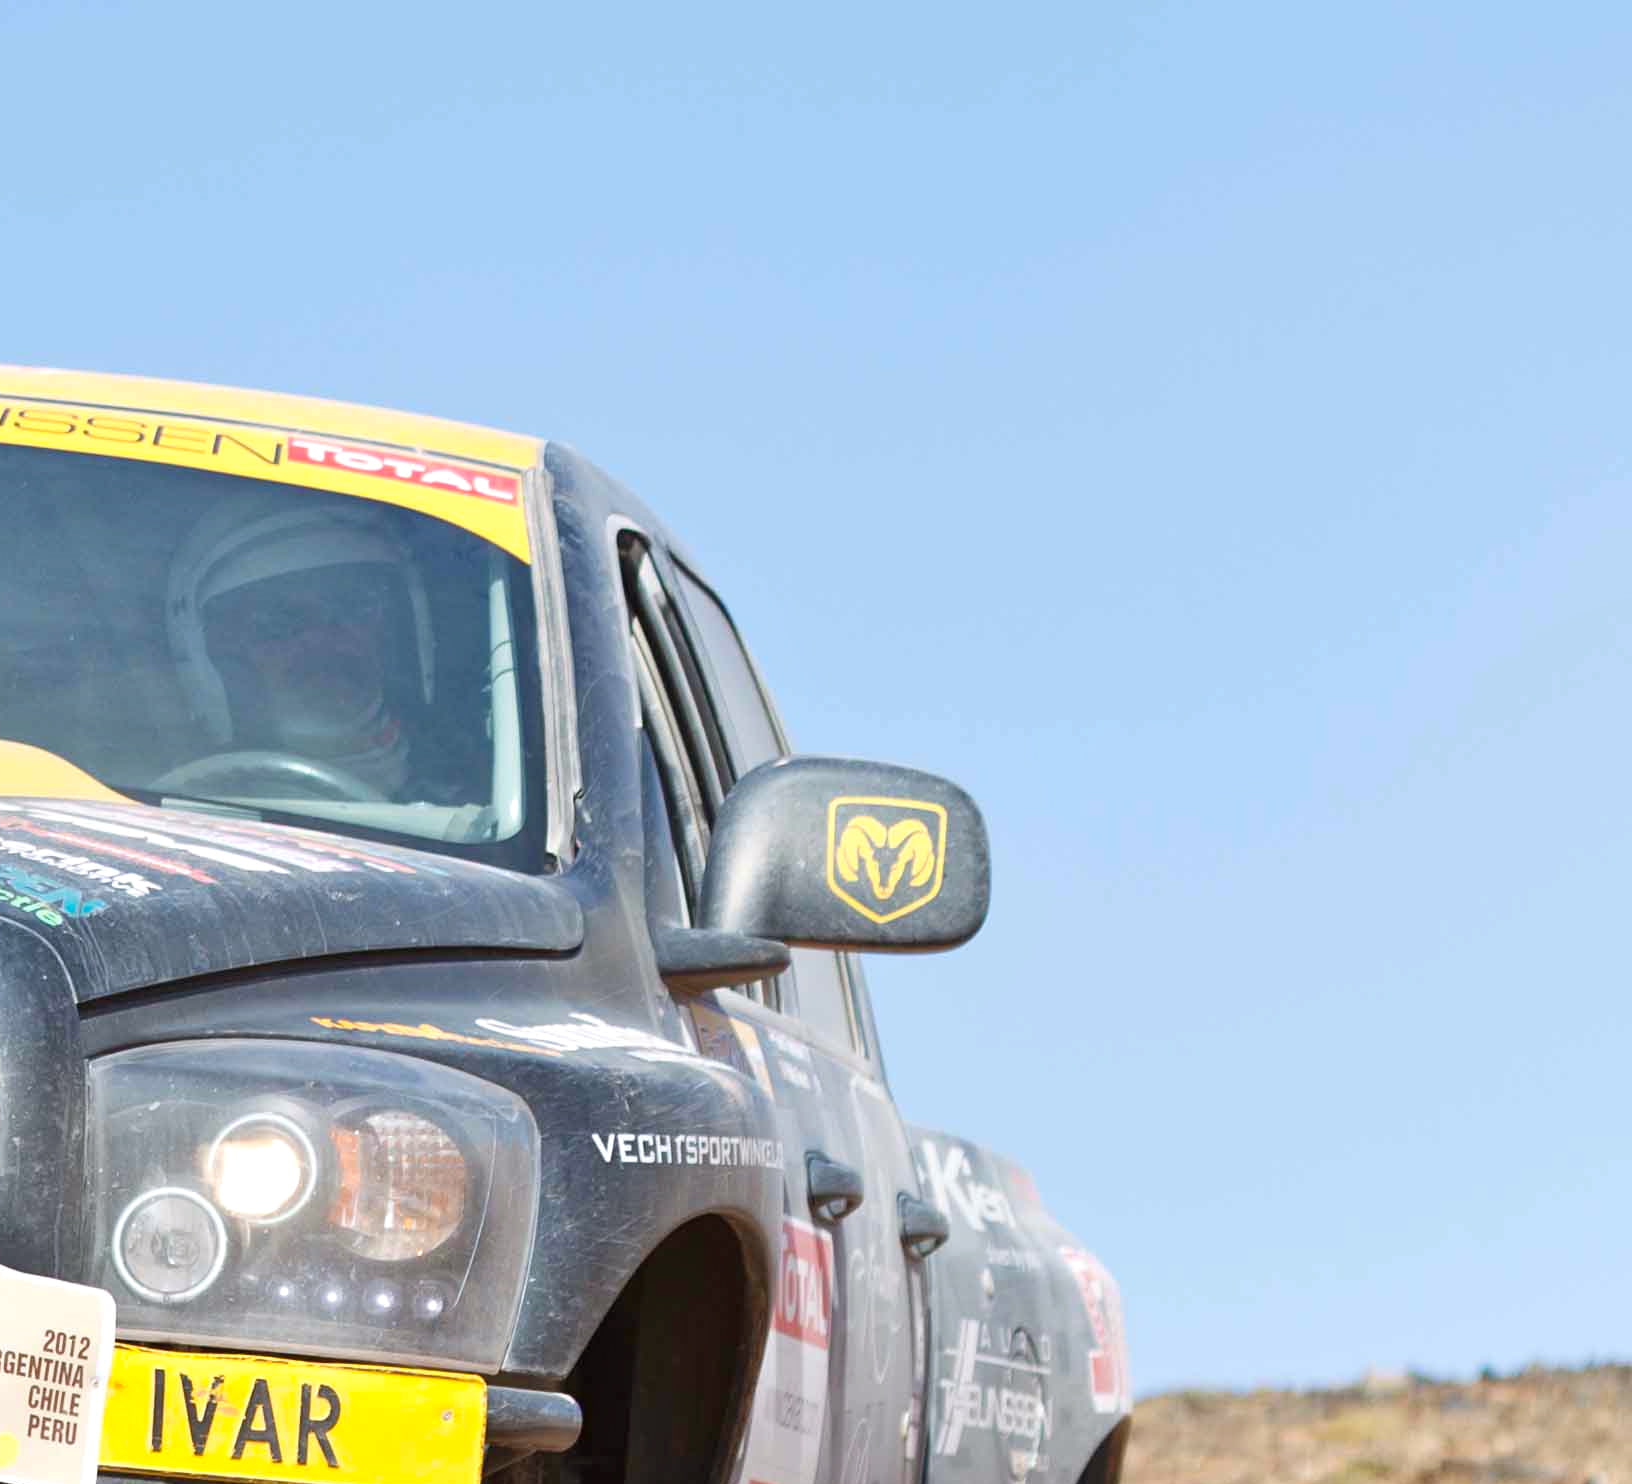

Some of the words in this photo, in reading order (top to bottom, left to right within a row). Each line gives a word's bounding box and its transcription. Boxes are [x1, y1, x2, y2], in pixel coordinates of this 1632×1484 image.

[295, 439, 516, 501] TOTAL
[42, 1329, 91, 1360] 2012
[27, 1385, 81, 1417] CHILE
[26, 1412, 78, 1446] PERU
[149, 1368, 343, 1470] IVAR
